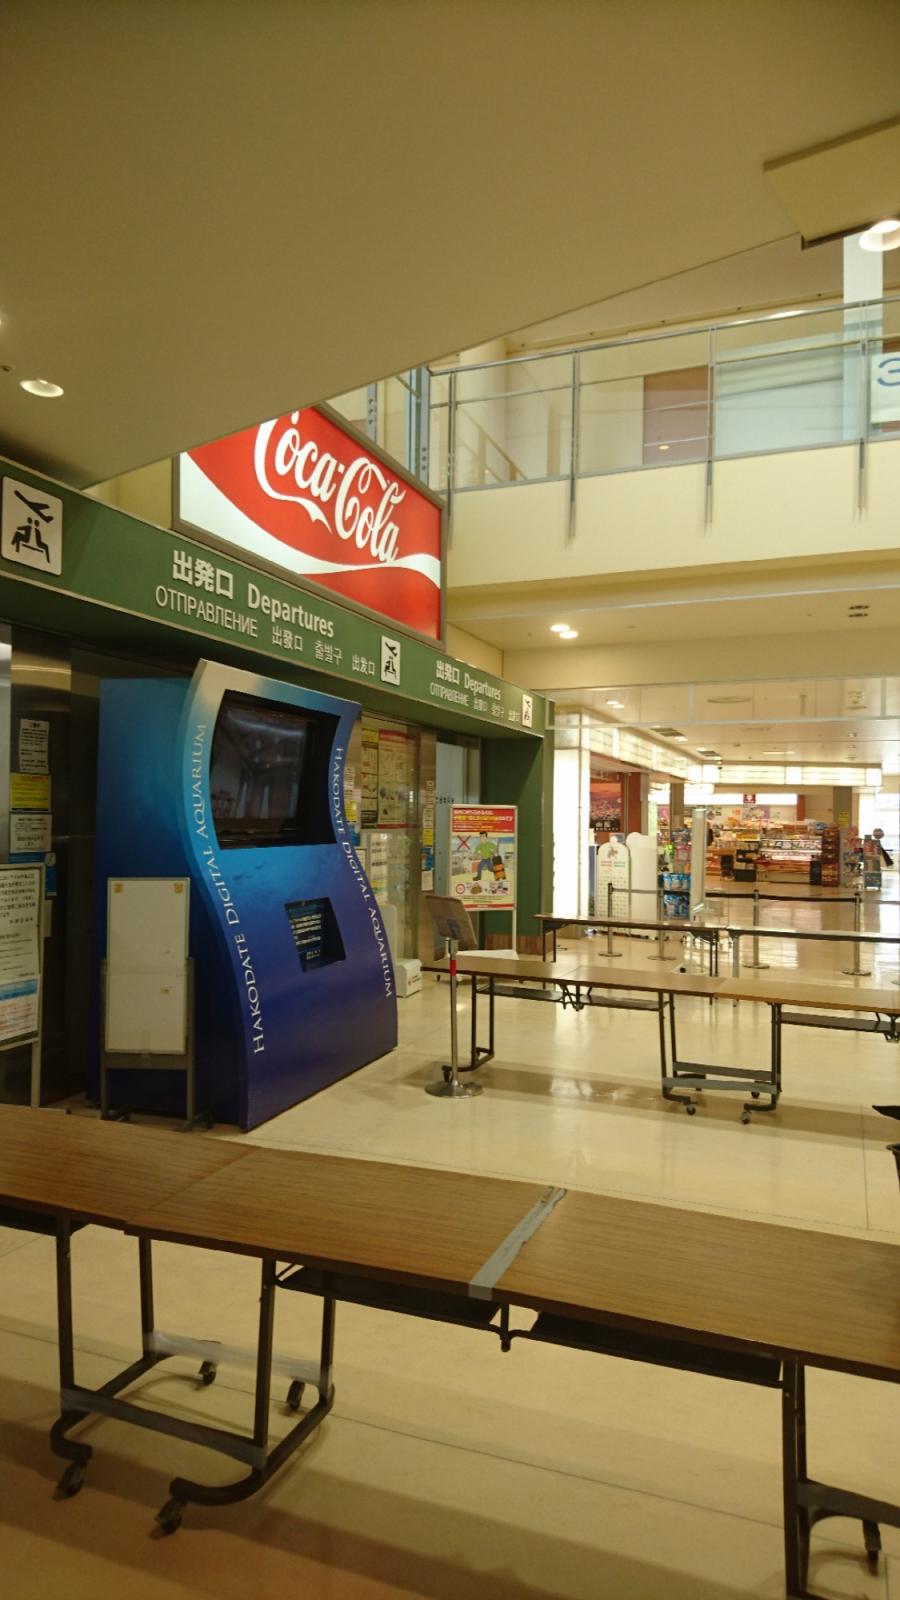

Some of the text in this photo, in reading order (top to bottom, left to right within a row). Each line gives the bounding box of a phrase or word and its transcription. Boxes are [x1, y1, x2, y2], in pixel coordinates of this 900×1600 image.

[254, 409, 406, 563] Coca-Cola
[172, 550, 234, 600] 出発口
[155, 585, 259, 639] ОТПРАВЛЕНИЕ
[248, 583, 334, 638] Departures
[435, 660, 460, 685] 出発口
[464, 672, 502, 701] Departures
[191, 724, 265, 1055] HAKODATE DIGITAL AQUARIUM
[332, 747, 393, 998] HAKODATE DIGITAL AQUARIUM
